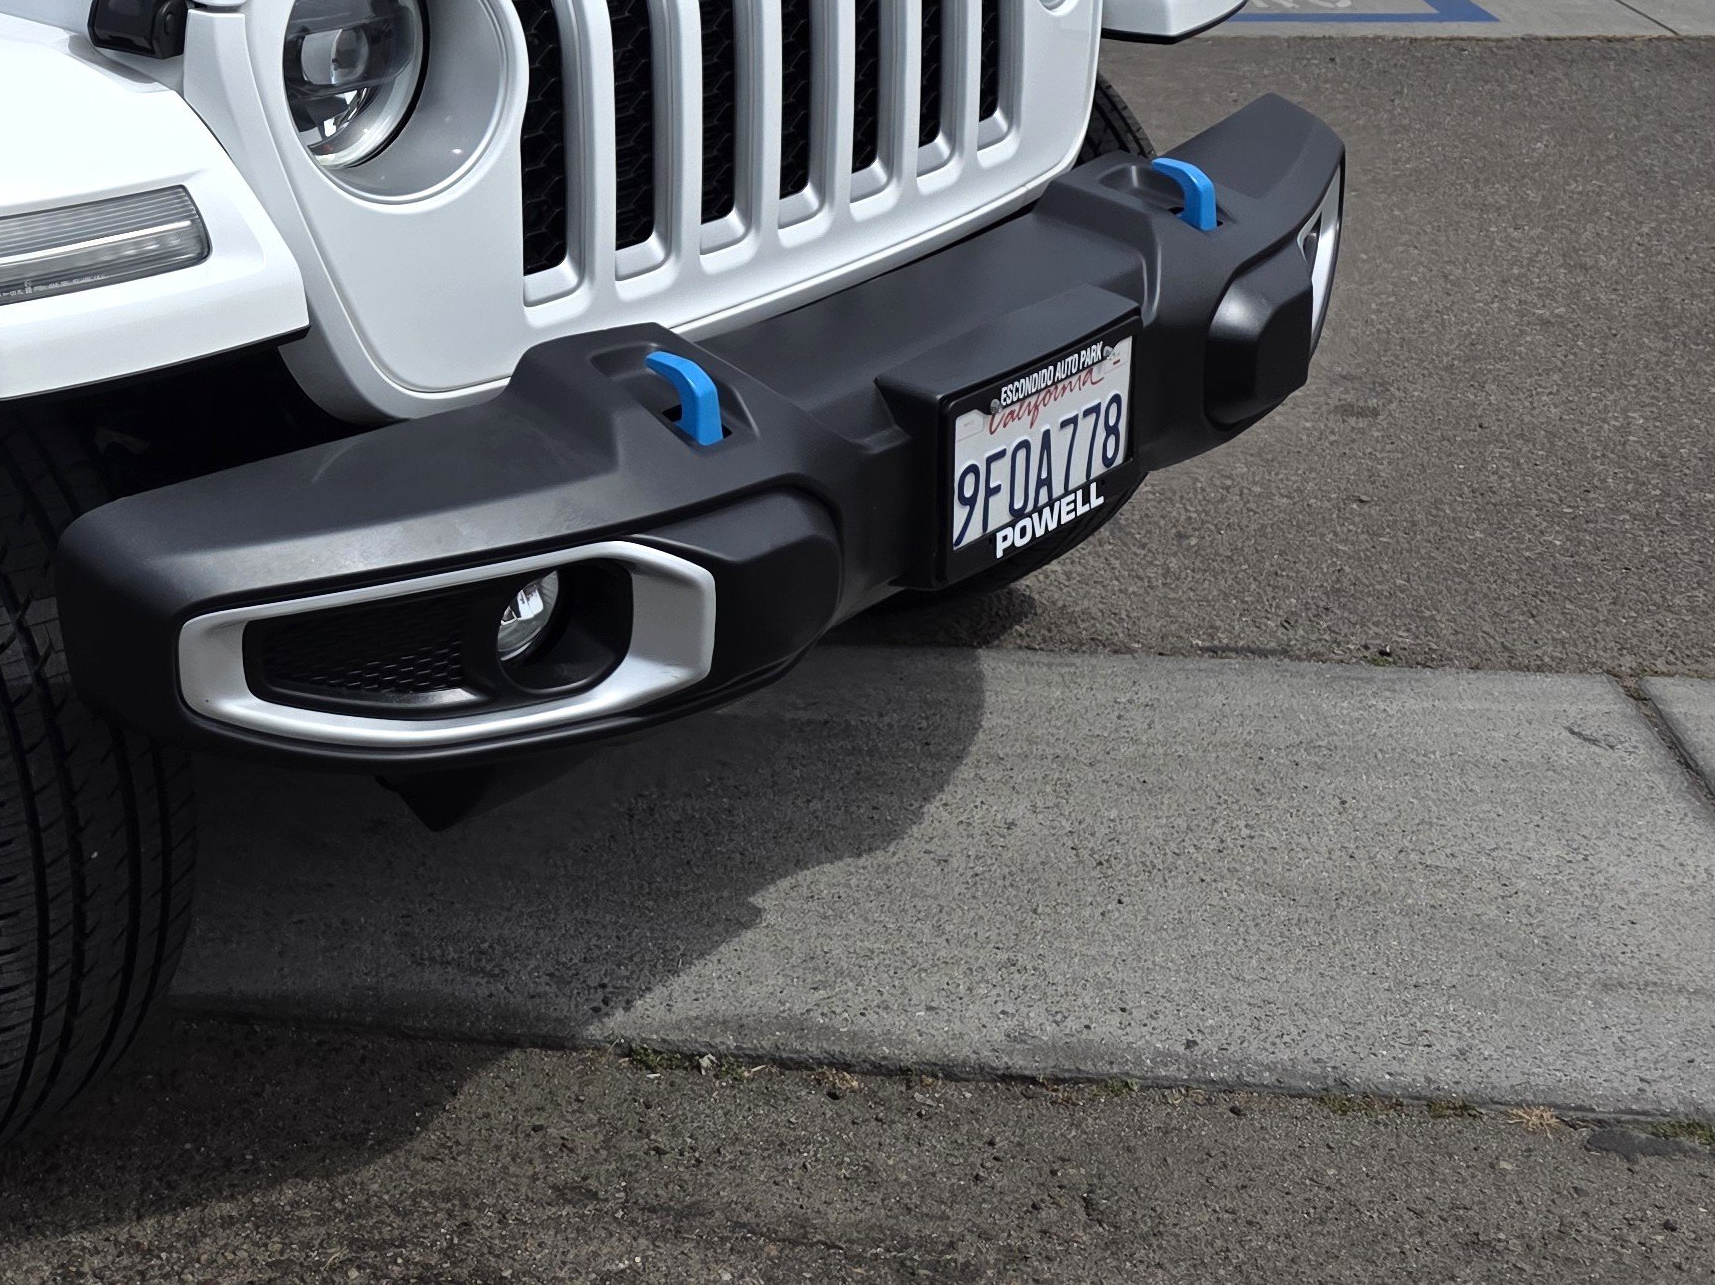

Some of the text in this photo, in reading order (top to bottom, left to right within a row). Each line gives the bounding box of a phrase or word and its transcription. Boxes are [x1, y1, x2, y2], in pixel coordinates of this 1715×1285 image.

[989, 367, 1105, 435] California
[1000, 340, 1104, 406] ESCONDIDO AUTO PARK
[995, 481, 1105, 559] POWELL
